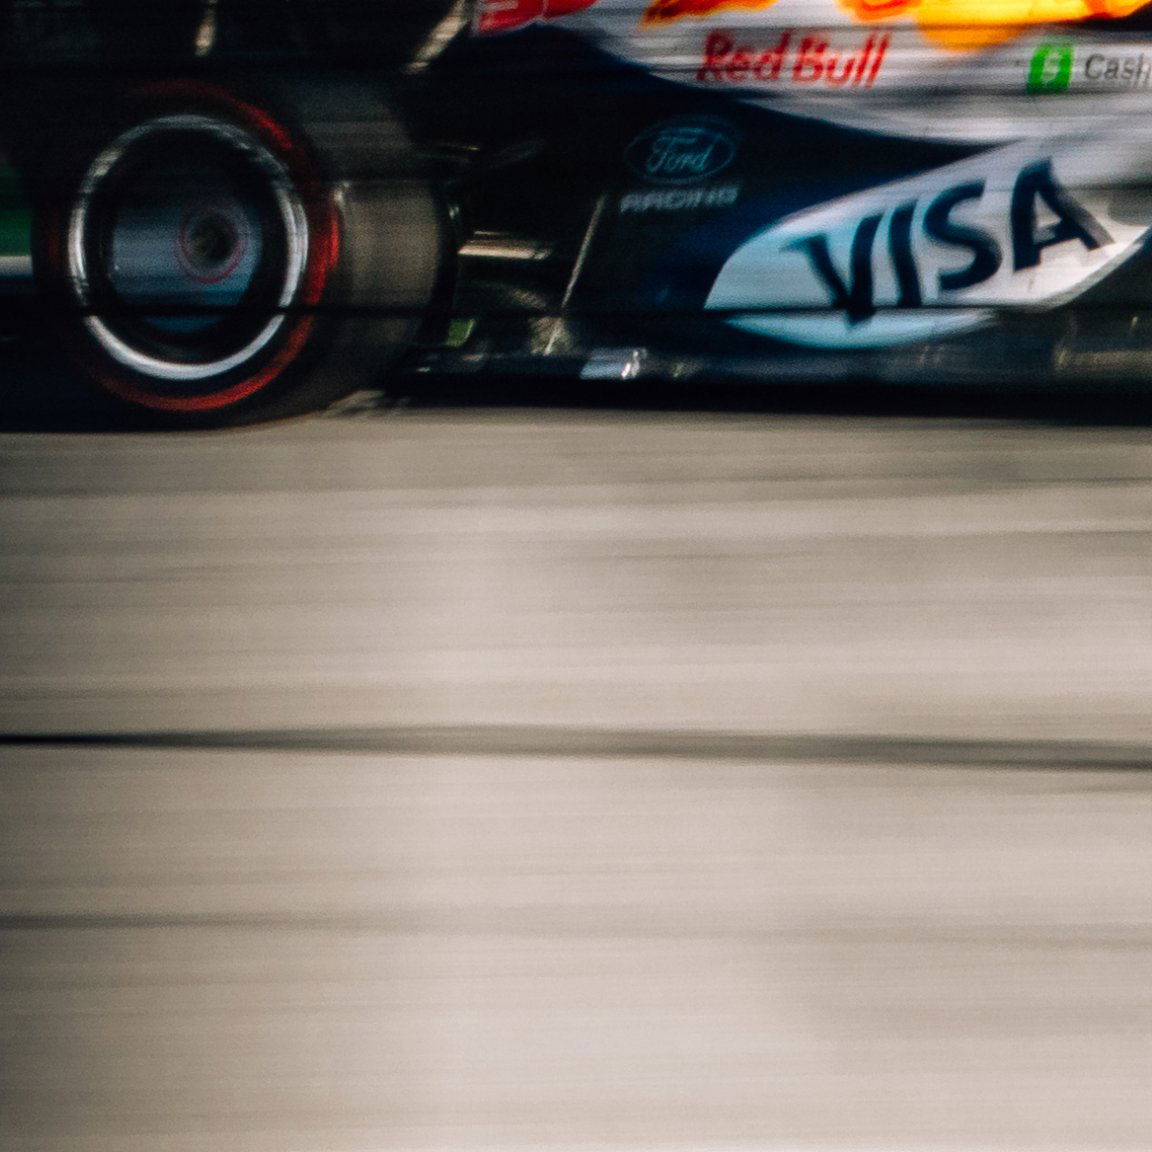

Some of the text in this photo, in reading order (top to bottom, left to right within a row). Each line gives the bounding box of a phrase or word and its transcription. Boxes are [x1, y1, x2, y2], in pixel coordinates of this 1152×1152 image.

[697, 28, 891, 89] Red Bull
[1085, 52, 1151, 88] Cash
[647, 132, 722, 173] Ford
[620, 187, 740, 212] RACING
[784, 160, 1115, 326] VISA
